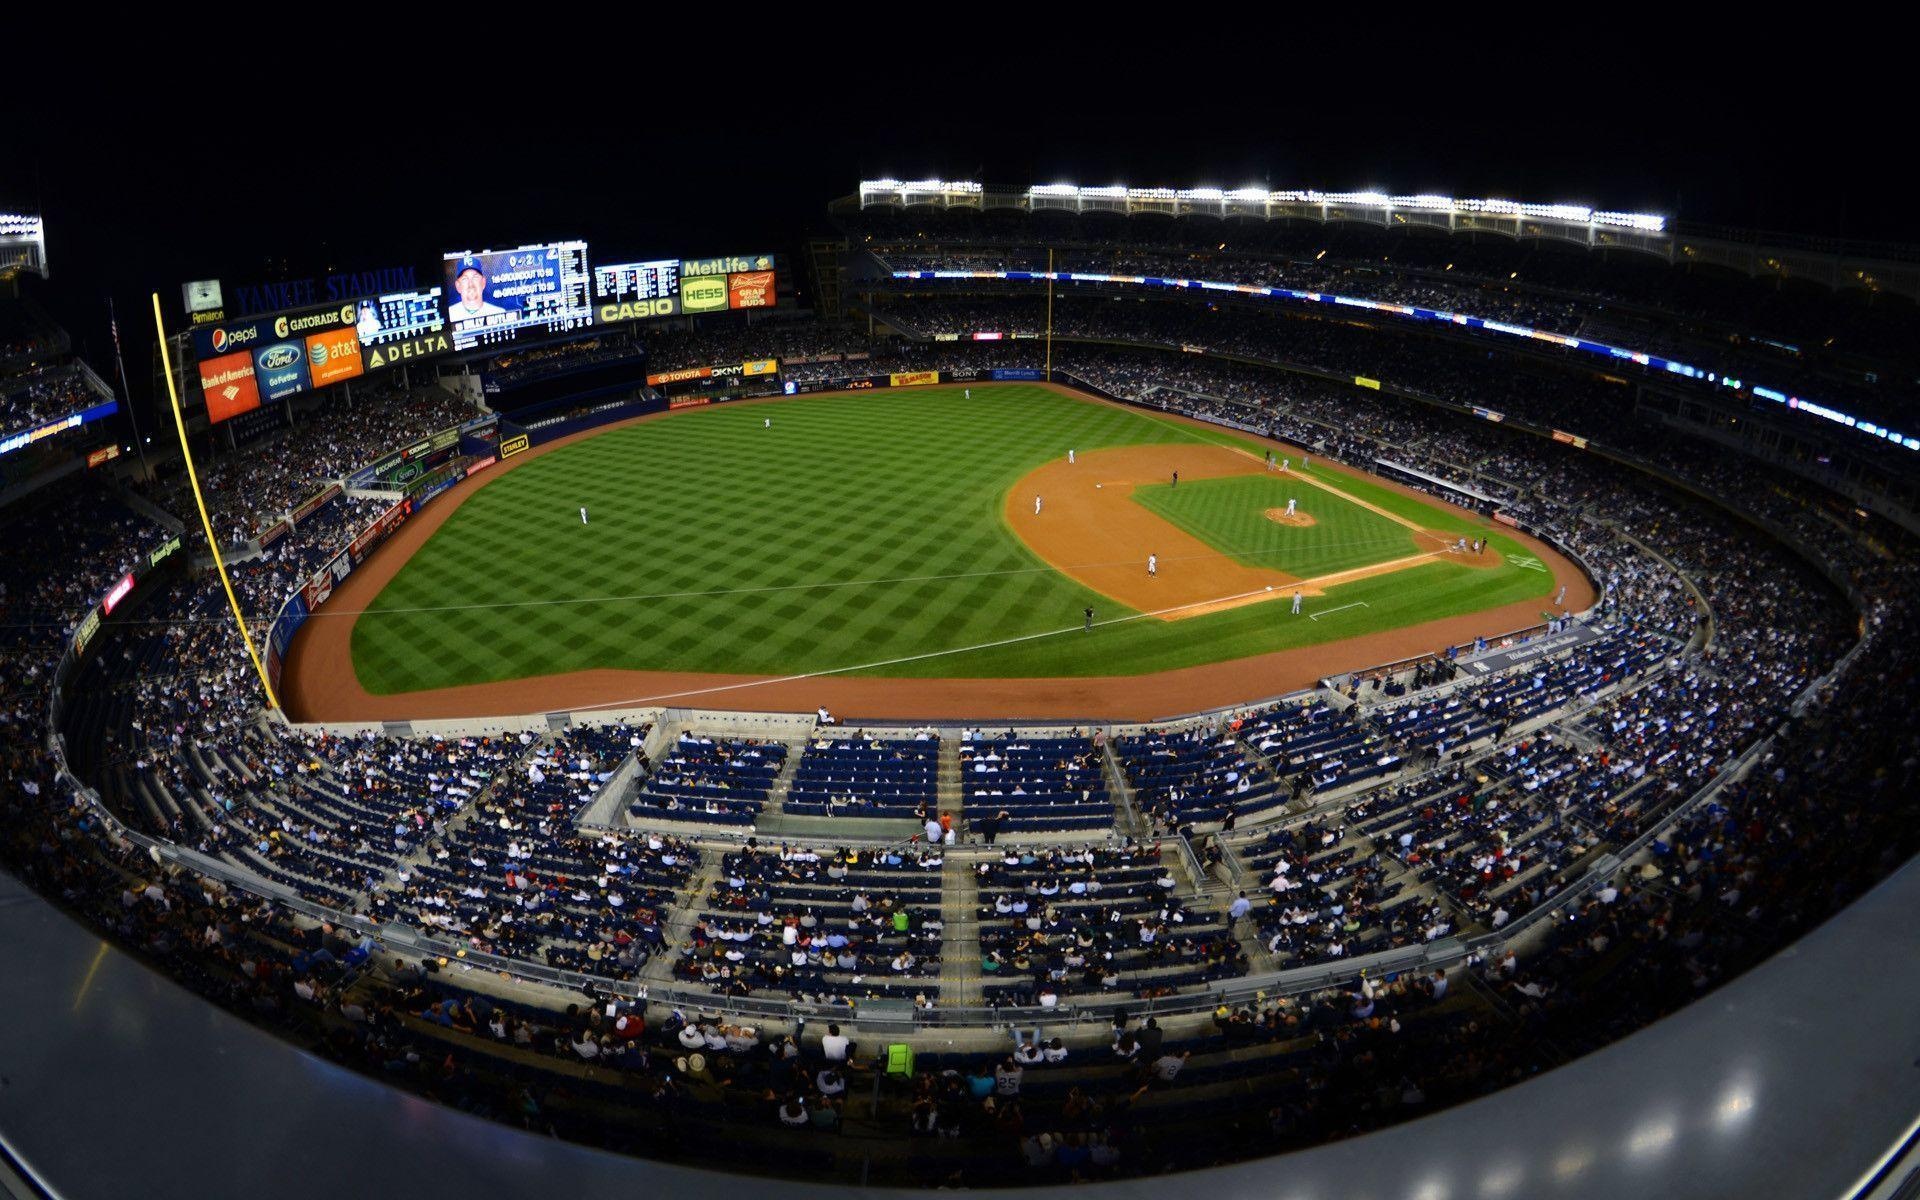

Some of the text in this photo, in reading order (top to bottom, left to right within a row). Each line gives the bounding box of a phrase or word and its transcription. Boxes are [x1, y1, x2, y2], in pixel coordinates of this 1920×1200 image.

[684, 257, 749, 277] MetLife
[326, 266, 416, 303] STADIUM
[686, 288, 724, 301] HESS
[739, 289, 766, 298] GRAB
[601, 298, 674, 322] CASIO
[740, 298, 766, 307] BUDS
[290, 312, 339, 332] GATORADE
[228, 325, 257, 346] pepsi
[267, 350, 293, 368] Ford
[331, 338, 358, 360] at&t
[388, 336, 449, 363] DELTA
[202, 366, 255, 389] Bank of America
[670, 369, 701, 382] TOYOTA
[711, 366, 743, 377] DKNY
[503, 438, 526, 454] STANLEY
